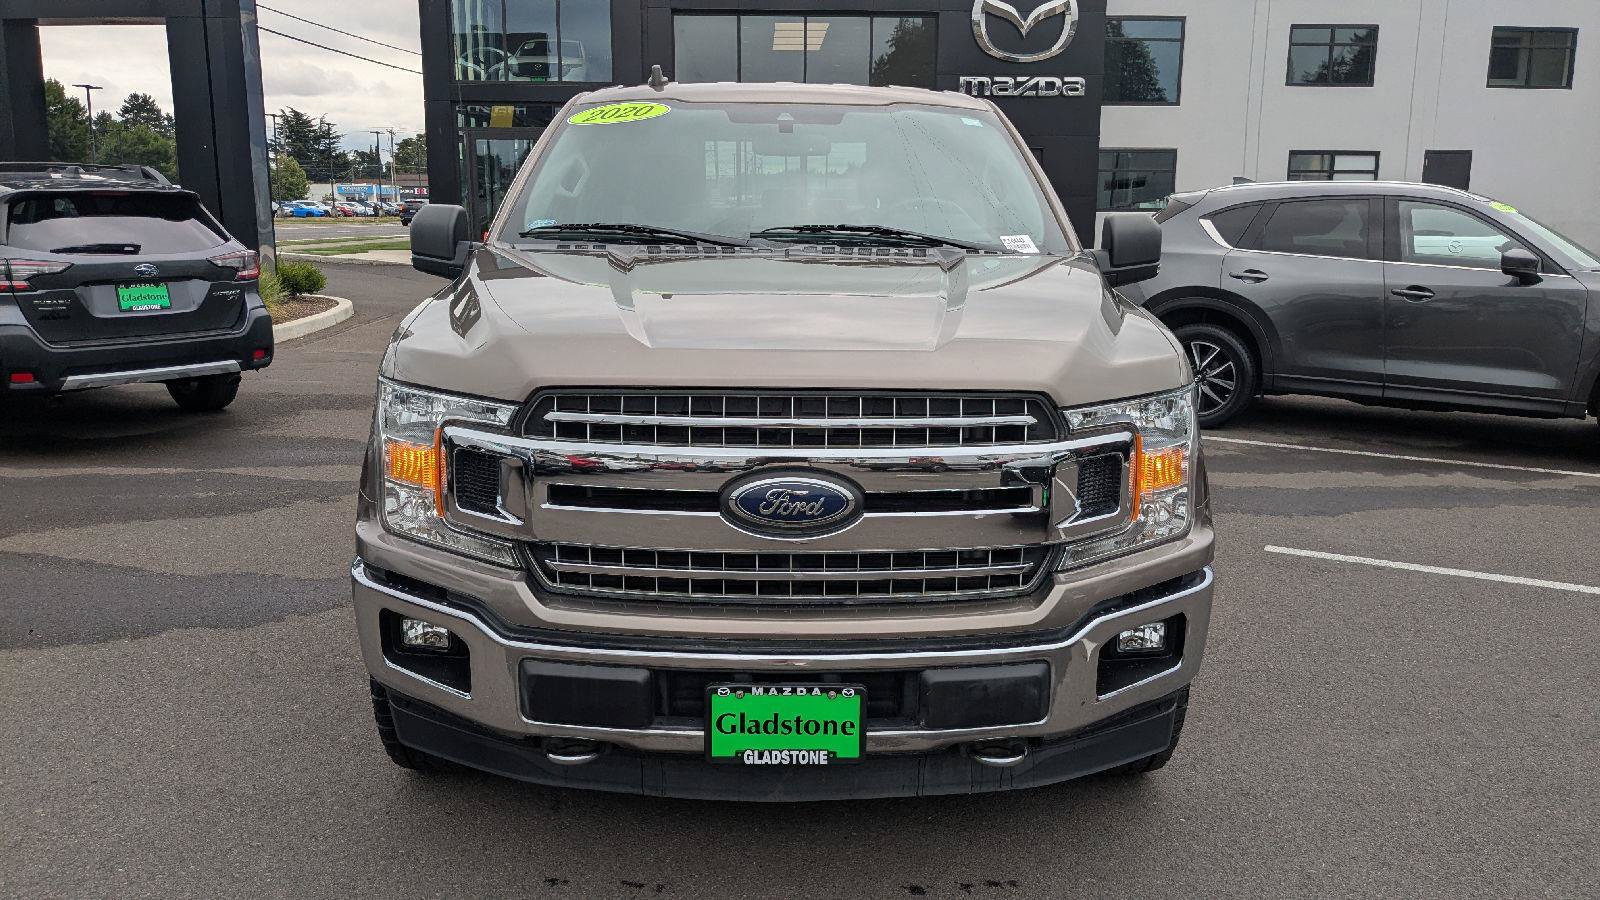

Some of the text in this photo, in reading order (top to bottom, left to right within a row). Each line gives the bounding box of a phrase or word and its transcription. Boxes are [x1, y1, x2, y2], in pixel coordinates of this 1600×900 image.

[582, 105, 655, 122] 2020
[121, 293, 168, 302] Gladstone
[758, 488, 826, 516] Ford
[751, 687, 822, 696] MAZDA
[715, 712, 856, 736] Gladstone
[743, 750, 828, 765] GLADSTONE
